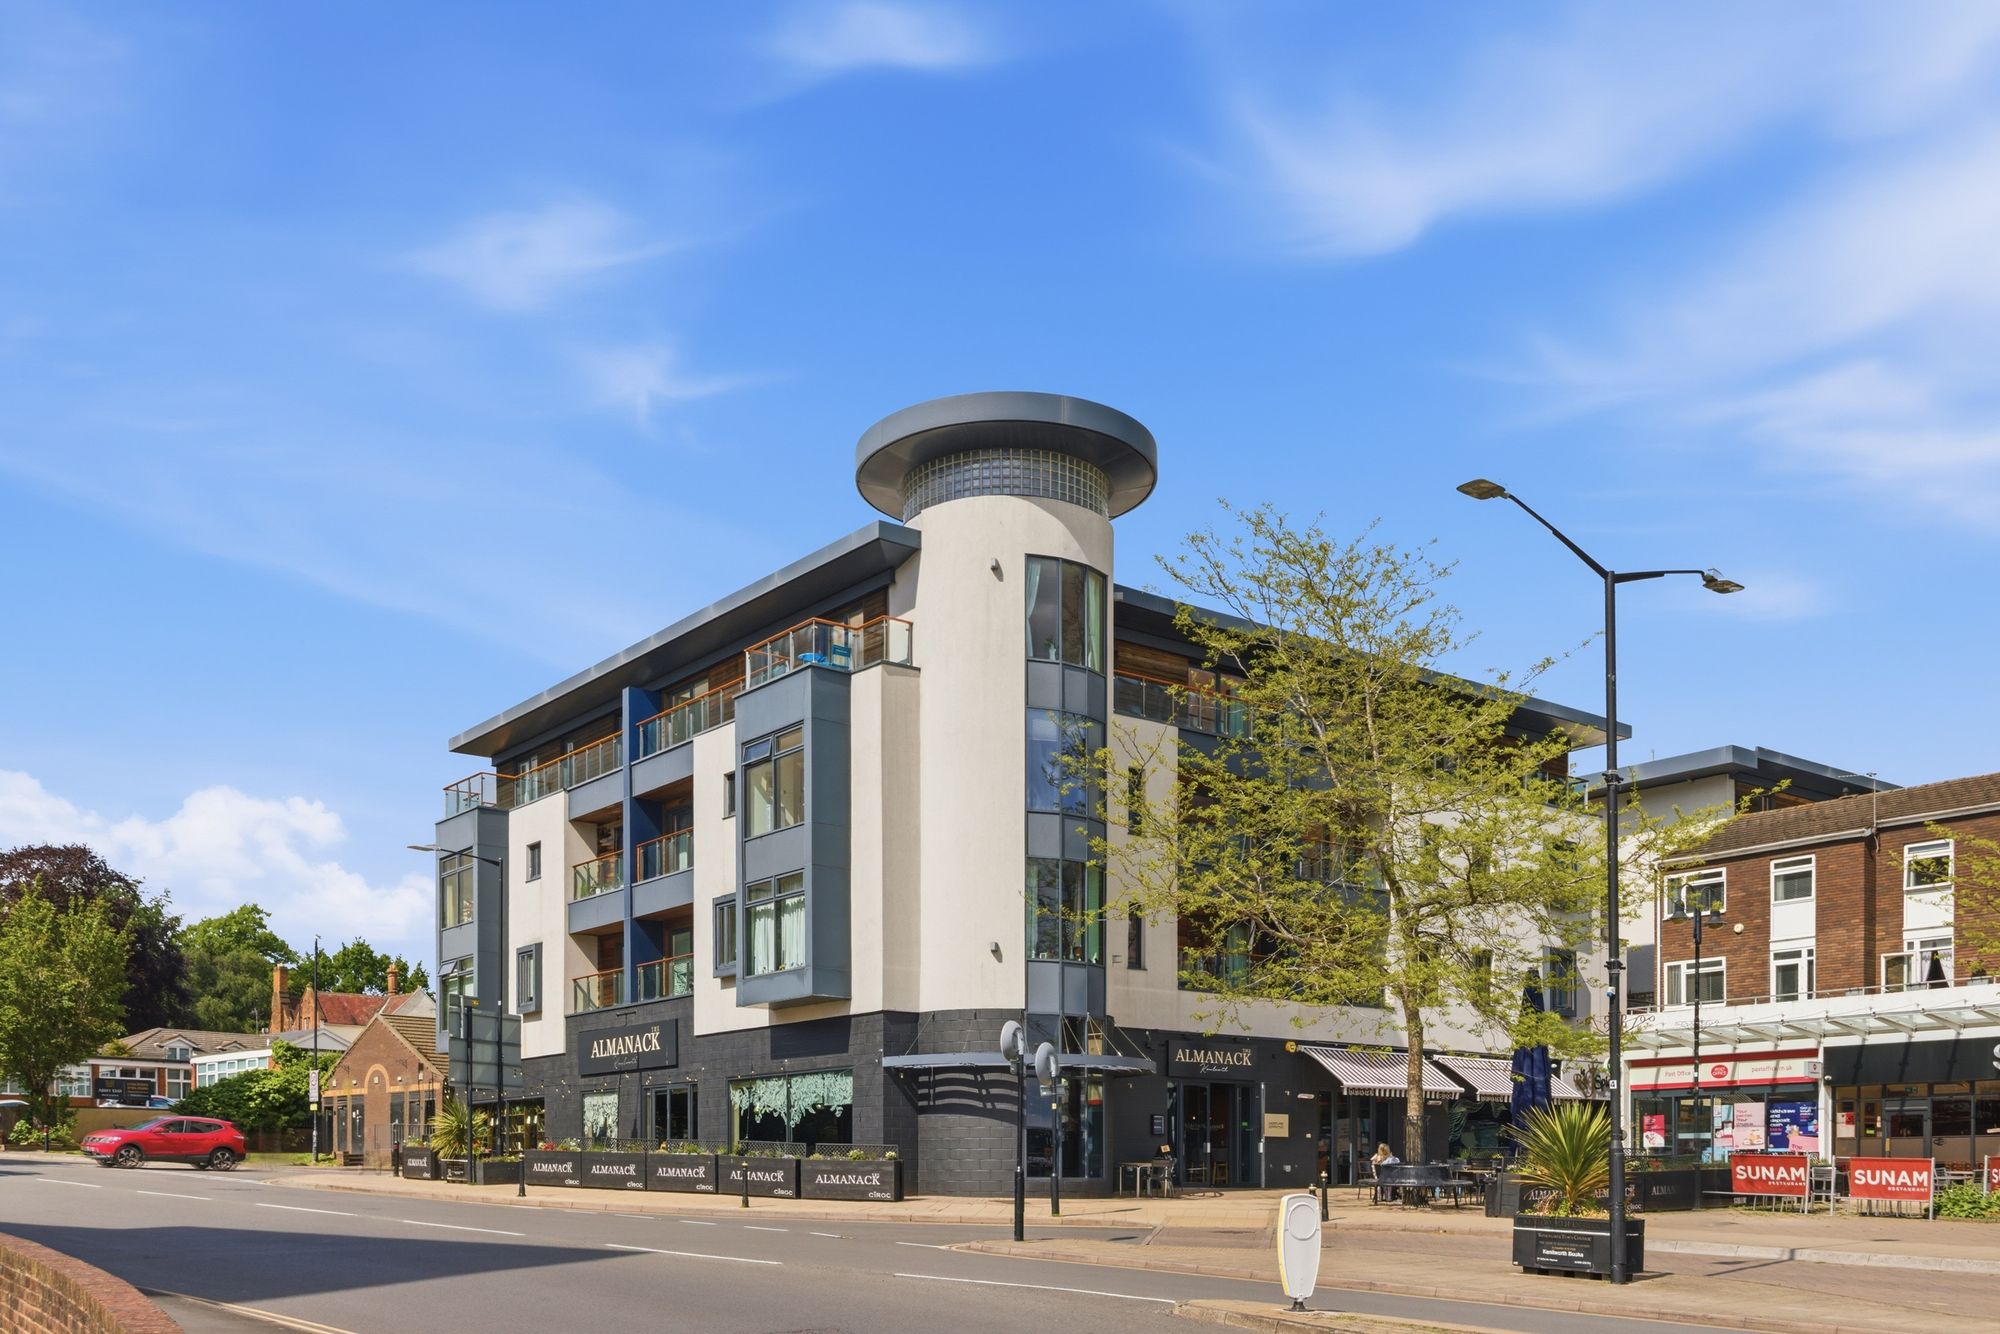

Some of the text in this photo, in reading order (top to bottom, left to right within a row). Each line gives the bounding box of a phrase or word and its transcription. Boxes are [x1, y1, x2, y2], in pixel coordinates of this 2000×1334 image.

[590, 1031, 661, 1059] ALMANACK
[1175, 1048, 1252, 1066] ALMANACK
[532, 1162, 573, 1173] ALMANACK
[591, 1165, 636, 1176] ALMANACK
[656, 1167, 705, 1178] ALMANACK
[1735, 1165, 1806, 1182] SUNAM
[815, 1174, 881, 1185] ALMANACK
[1854, 1169, 1929, 1187] SUNAM
